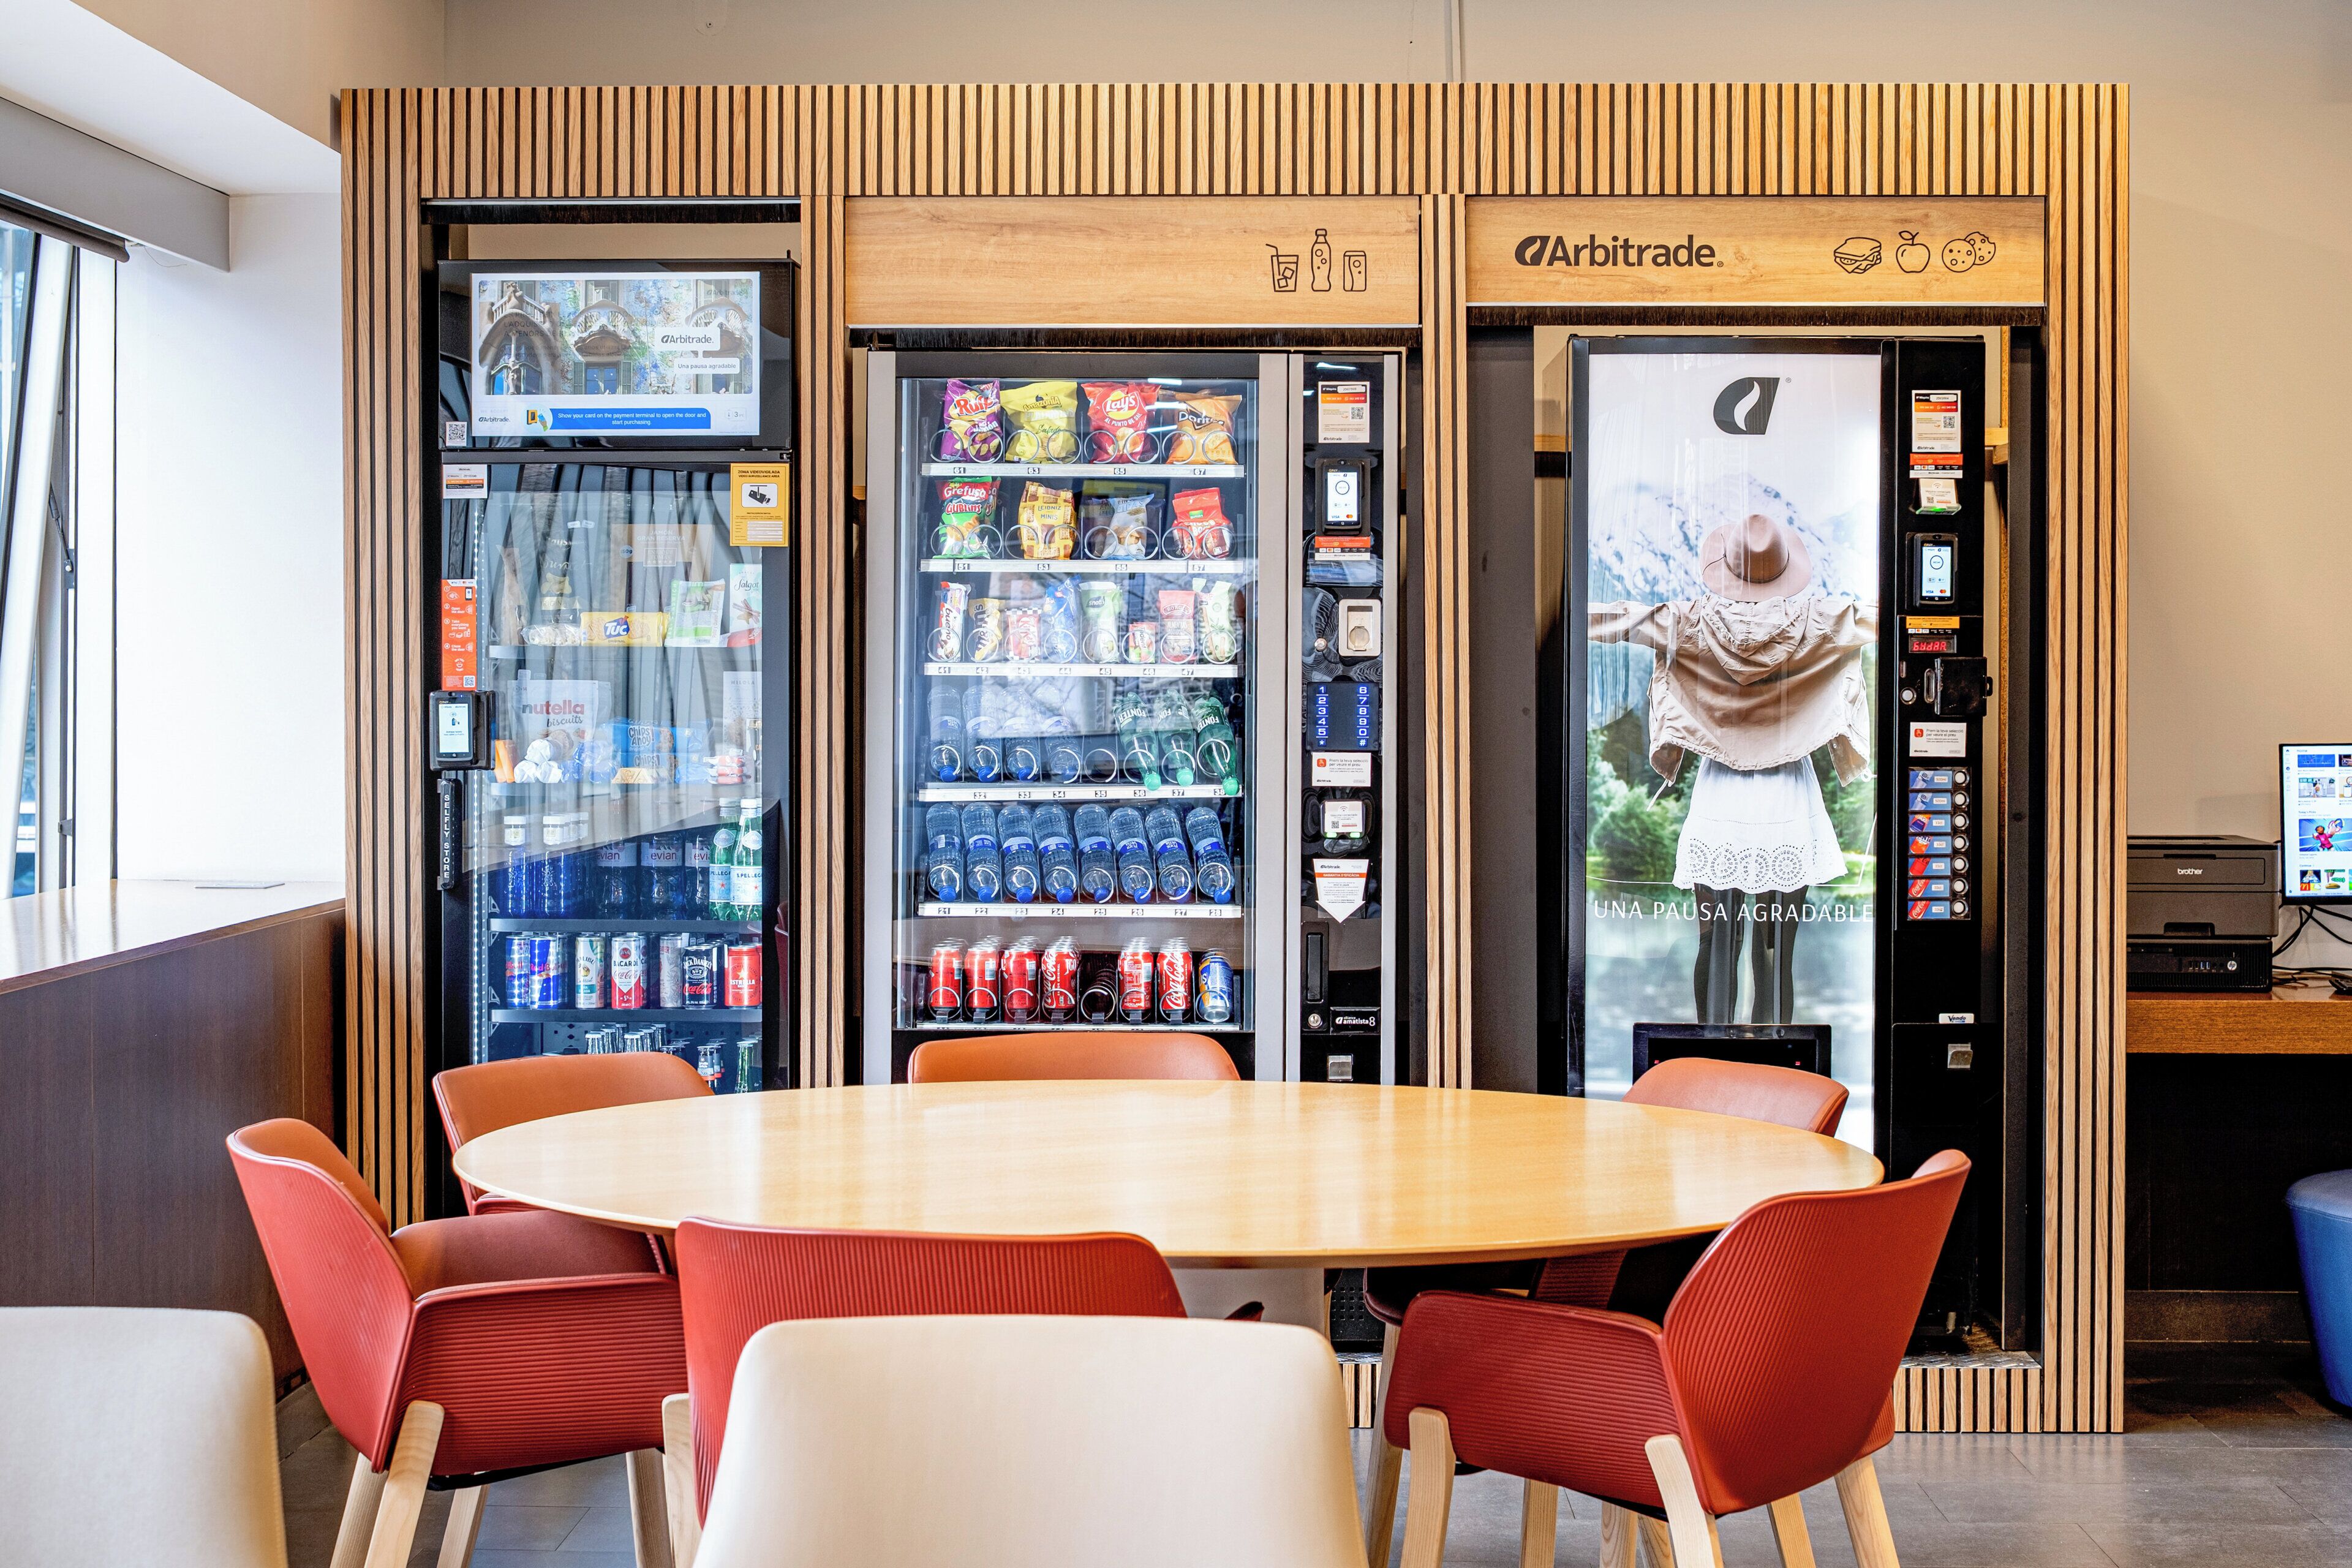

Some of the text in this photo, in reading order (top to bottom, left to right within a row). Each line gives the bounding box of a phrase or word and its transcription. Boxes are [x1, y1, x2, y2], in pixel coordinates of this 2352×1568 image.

[1547, 234, 1716, 266] Arbitrade
[1105, 394, 1137, 412] Lay's
[944, 486, 986, 498] Grefusa
[605, 622, 627, 635] TUC
[522, 699, 584, 715] nutella
[547, 715, 583, 728] biscuits
[650, 851, 677, 861] evian
[1594, 900, 1873, 923] UNA PAUSA AGRADABLE
[1162, 951, 1183, 1010] Coca-Cola
[1369, 1016, 1376, 1027] 8
